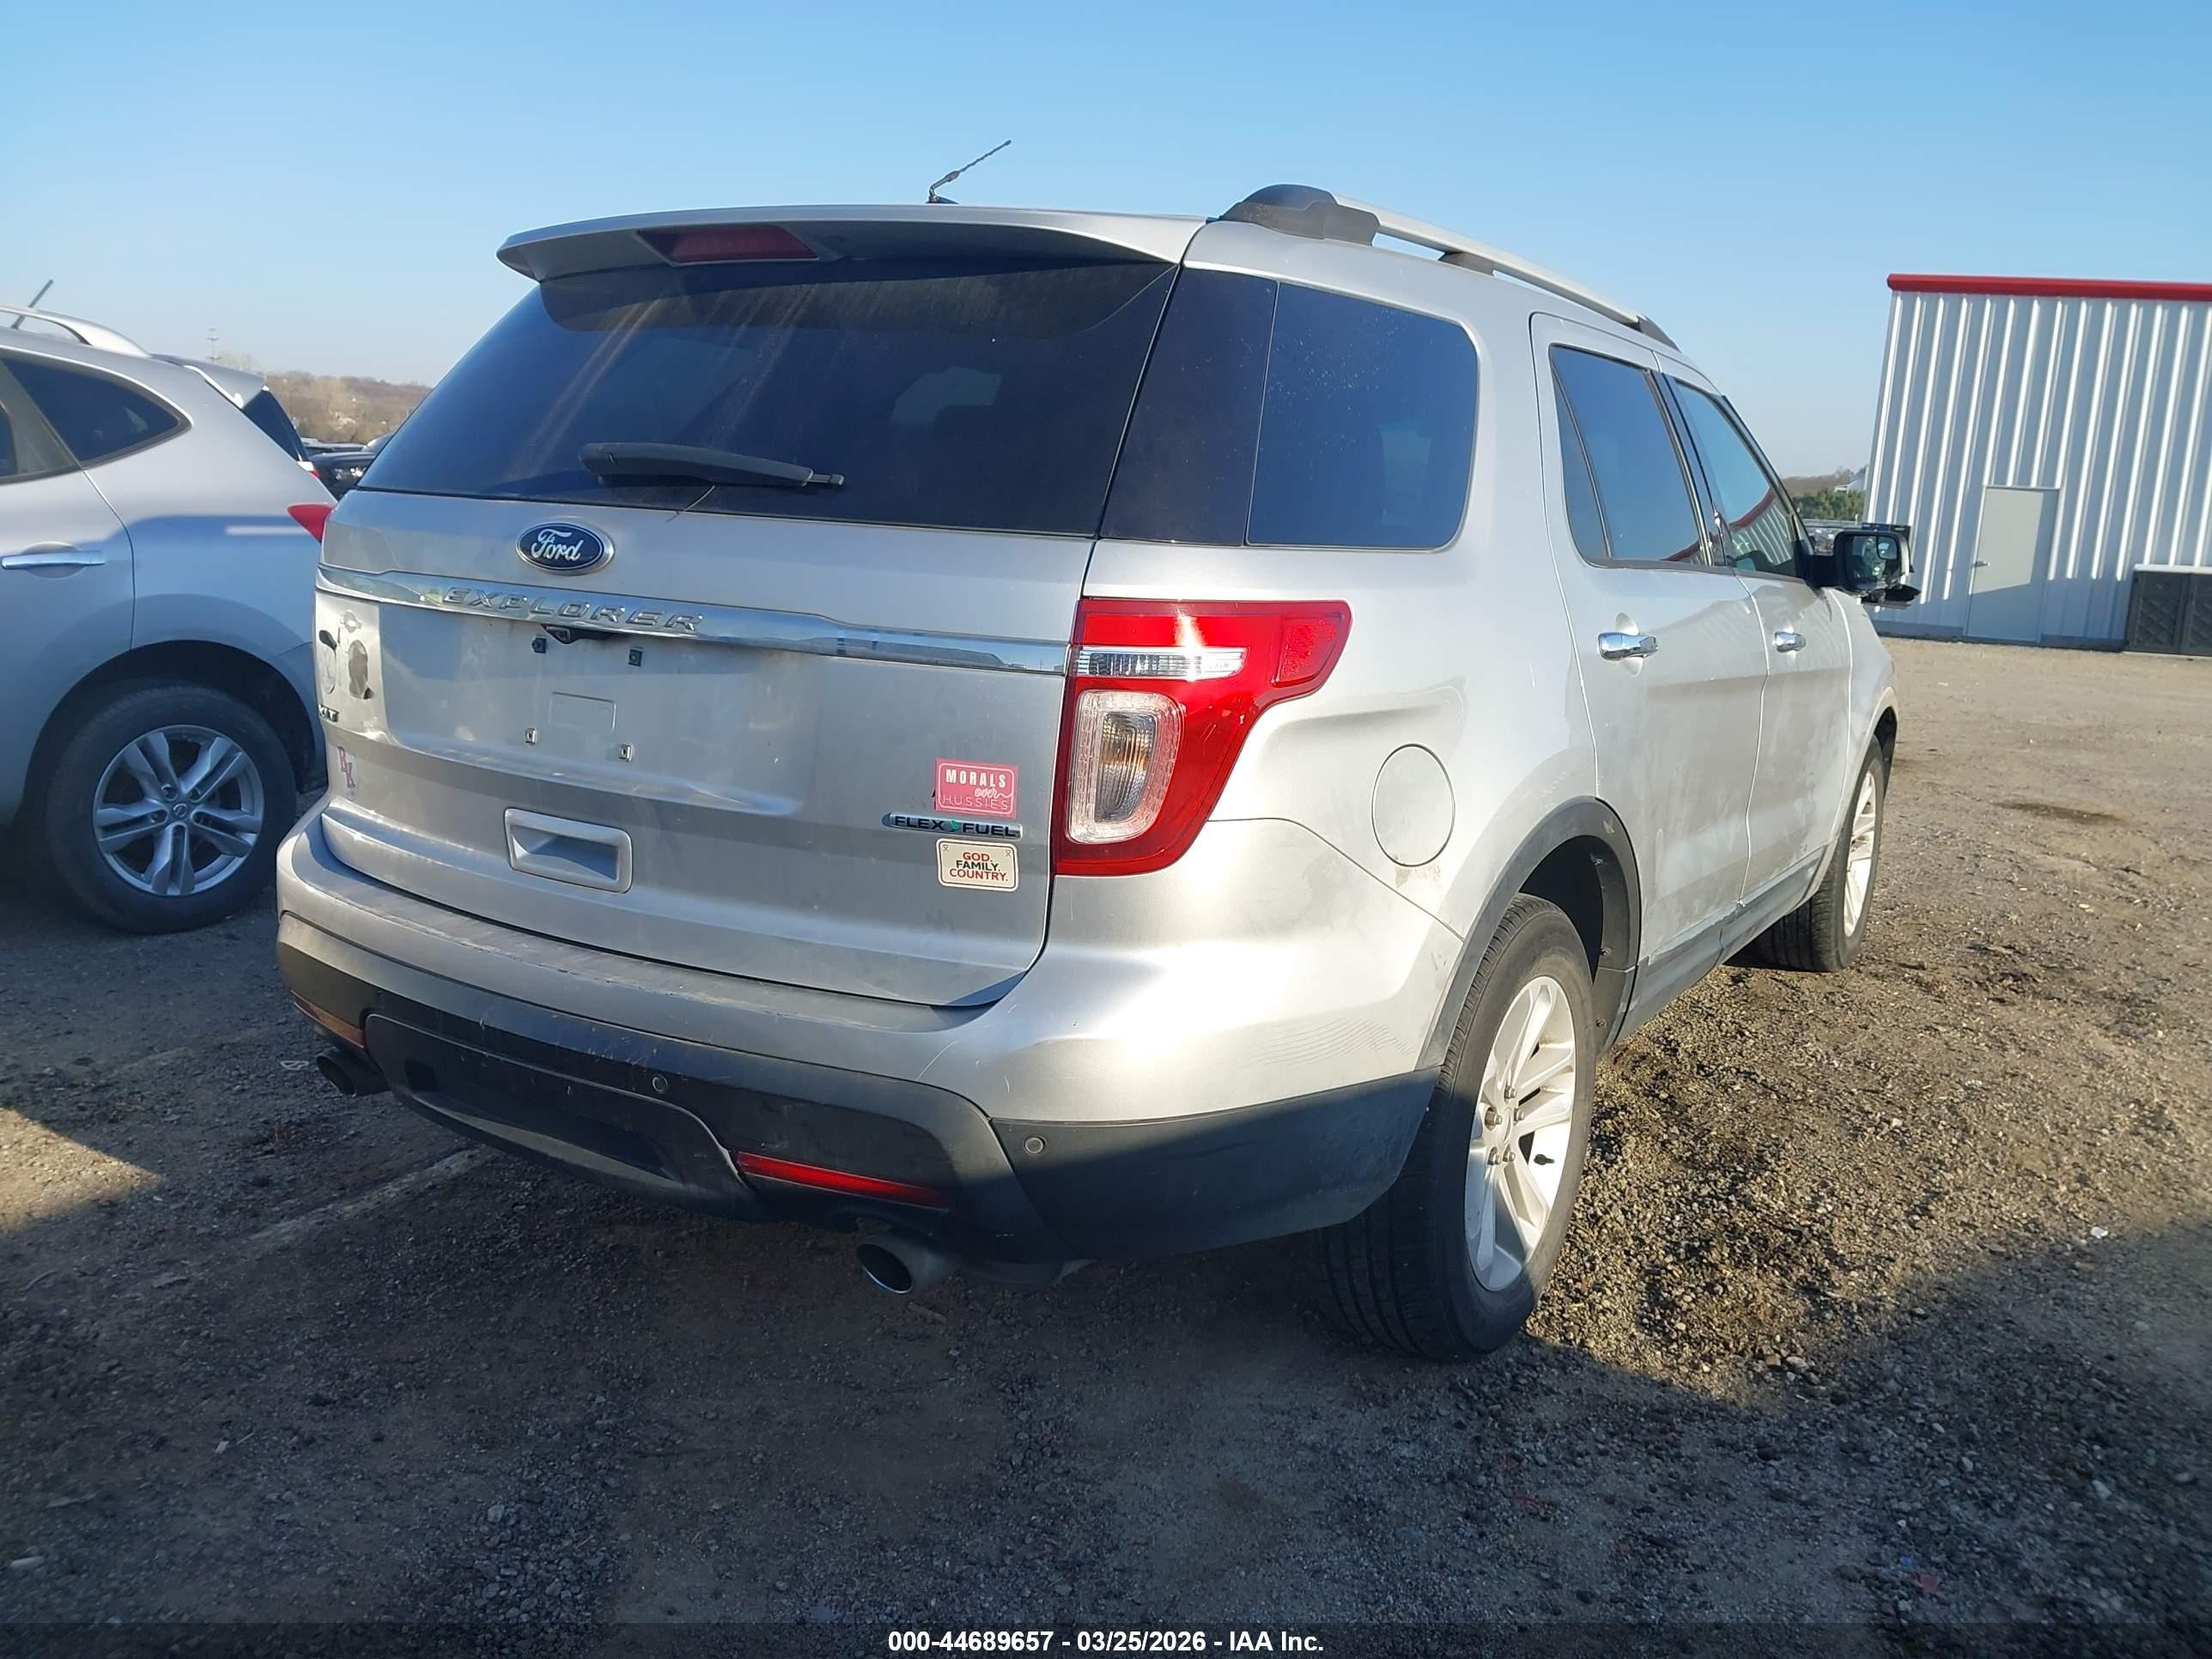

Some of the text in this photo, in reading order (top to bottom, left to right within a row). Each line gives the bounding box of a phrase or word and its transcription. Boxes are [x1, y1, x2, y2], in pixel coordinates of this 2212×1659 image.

[531, 528, 584, 562] Ford
[442, 586, 704, 631] EXPLORER
[945, 769, 1006, 788] MORALS
[943, 794, 1009, 810] HUSSIES
[894, 816, 1016, 837] FLEX FUEL
[956, 860, 1000, 872] FAMILY.
[962, 852, 993, 863] GOD.
[949, 868, 1008, 882] COUNTRY.
